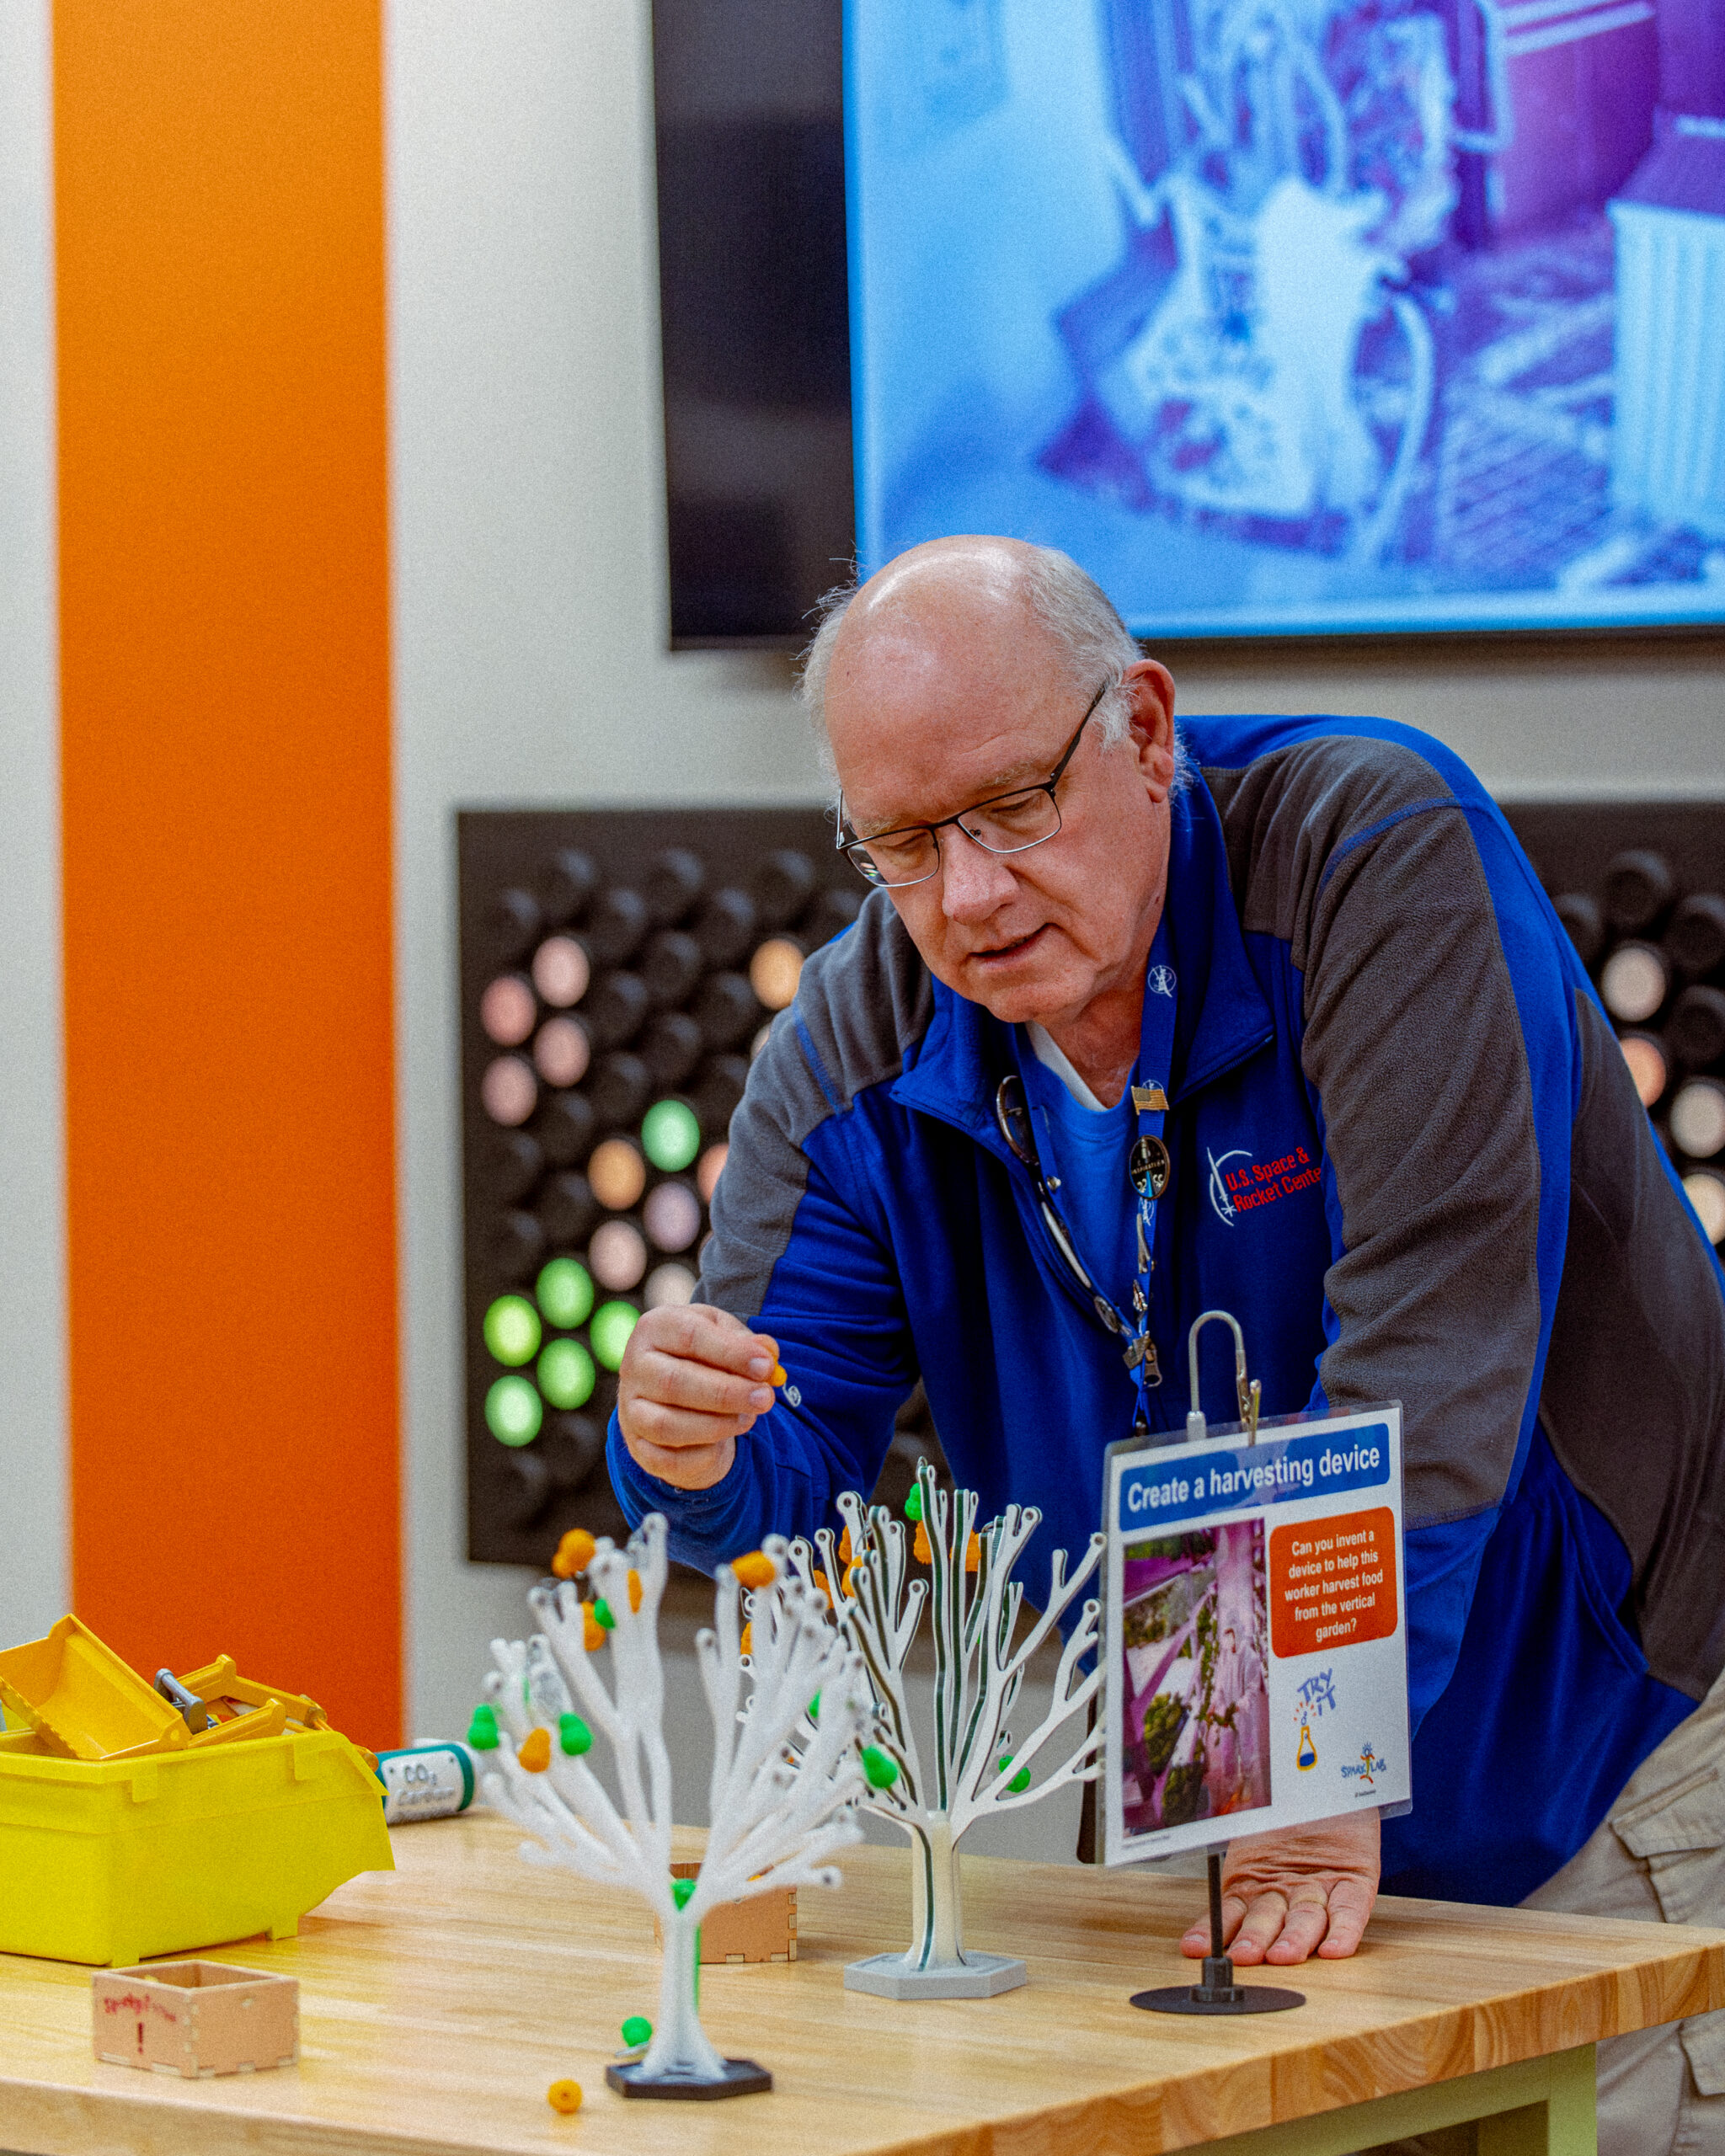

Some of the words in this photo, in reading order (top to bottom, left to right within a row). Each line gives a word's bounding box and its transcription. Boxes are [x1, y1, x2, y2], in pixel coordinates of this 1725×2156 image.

[1225, 1169, 1254, 1191] U.S.
[1252, 1155, 1296, 1183] Space
[1295, 1146, 1311, 1165] &
[1233, 1182, 1283, 1213] Rocket
[1281, 1167, 1322, 1194] Cente
[1127, 1478, 1189, 1513] Create
[1194, 1477, 1204, 1499] a
[1210, 1457, 1313, 1496] harvesting
[1319, 1444, 1381, 1477] device
[1291, 1541, 1312, 1556] Can
[1315, 1538, 1333, 1556] you
[1336, 1529, 1366, 1548] invent
[1369, 1530, 1375, 1541] a
[1289, 1561, 1322, 1579] device
[1324, 1559, 1335, 1572] to
[1338, 1553, 1359, 1571] help
[1361, 1549, 1379, 1565] this
[1284, 1582, 1320, 1601] worker
[1322, 1575, 1359, 1594] harvest
[1362, 1569, 1383, 1586] food
[1295, 1606, 1318, 1621] from
[1322, 1601, 1337, 1616] the
[1340, 1592, 1375, 1612] vertical
[1316, 1617, 1357, 1642] garden?
[1297, 1668, 1332, 1702] TRY
